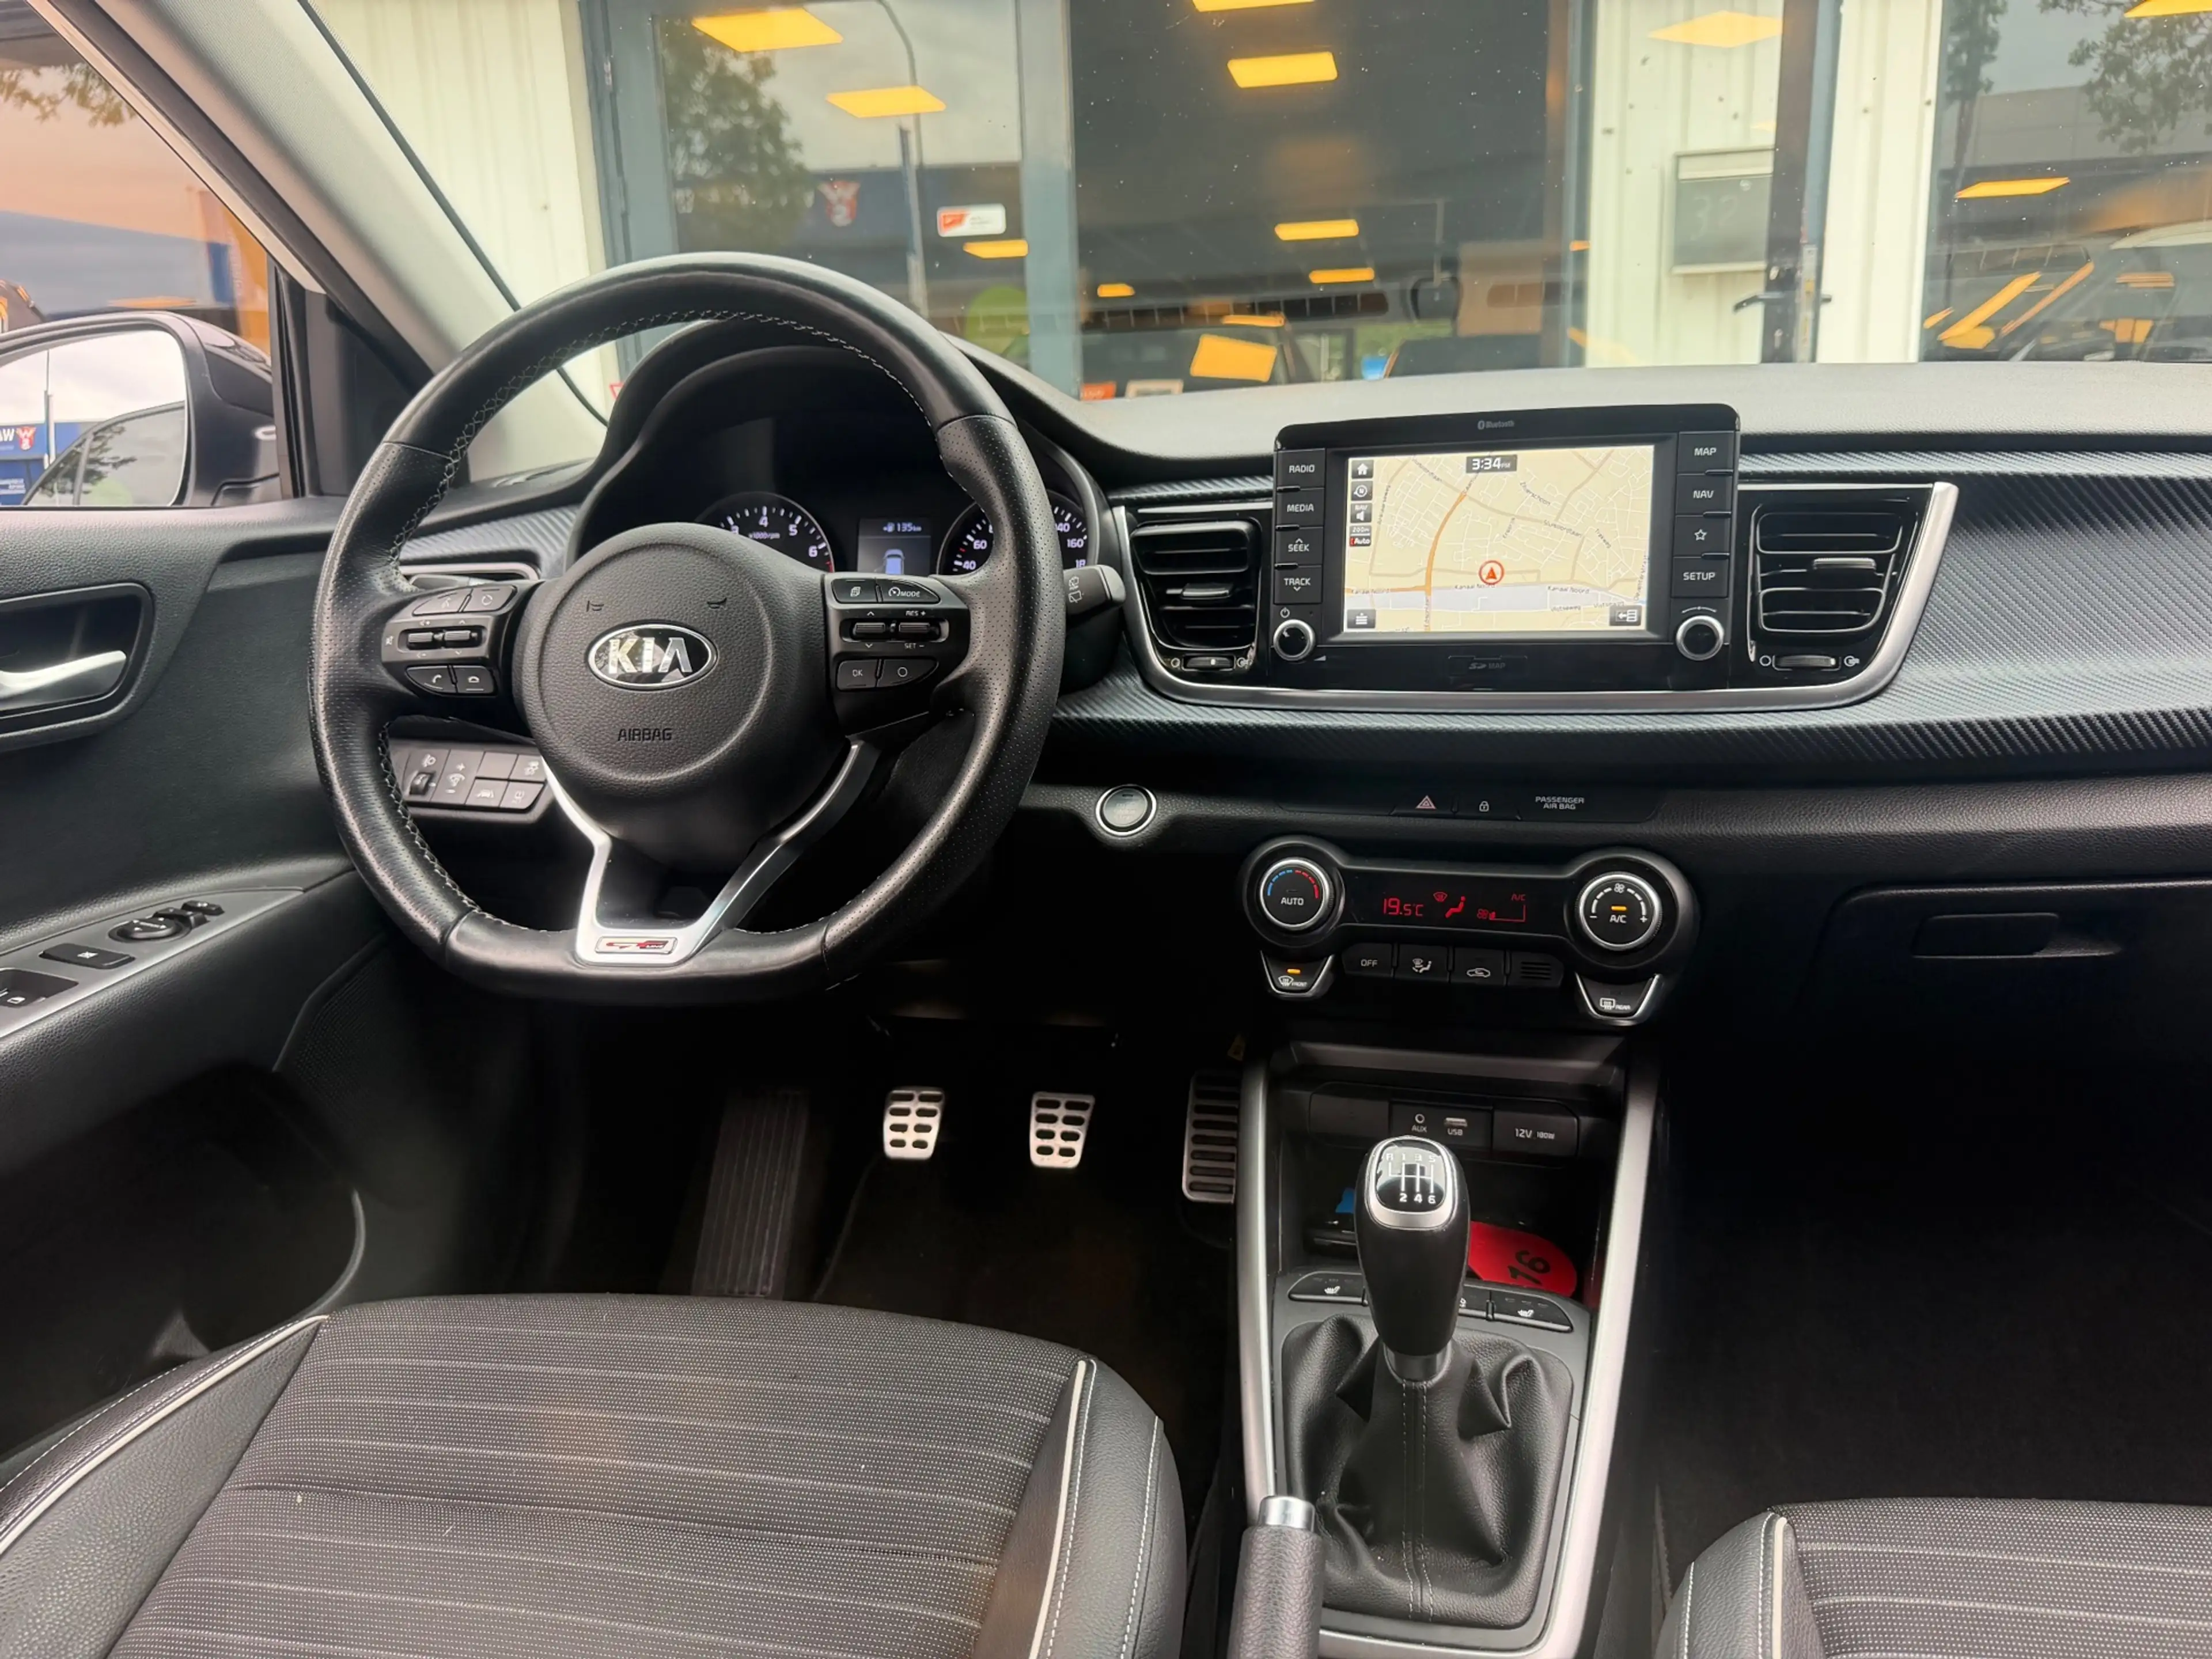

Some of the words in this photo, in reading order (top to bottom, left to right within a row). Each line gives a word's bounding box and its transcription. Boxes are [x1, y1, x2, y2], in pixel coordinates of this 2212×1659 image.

[1694, 447, 1717, 456] MAP
[1289, 464, 1315, 473] RADIO
[1472, 458, 1502, 470] 3:34
[1693, 490, 1714, 499] NAV
[1286, 503, 1314, 512] MEDIA
[759, 516, 768, 527] 4
[788, 524, 798, 536] 5
[973, 540, 987, 549] 60
[1067, 538, 1084, 548] 160
[1287, 544, 1310, 552] SEEK
[808, 546, 818, 558] 6
[963, 560, 976, 570] 40
[1683, 571, 1715, 581] SETUP
[1283, 578, 1311, 586] TRACK
[608, 637, 692, 674] KIA
[618, 728, 673, 742] AIRBAG
[1281, 897, 1304, 906] AUTO
[1609, 915, 1627, 923] A/C
[1361, 959, 1378, 967] OFF
[1411, 1124, 1427, 1132] AUX
[1515, 1128, 1532, 1138] 12V
[1399, 1192, 1407, 1202] 2
[1414, 1193, 1422, 1203] 4
[1428, 1195, 1436, 1204] 6
[1507, 1249, 1551, 1285] 16
